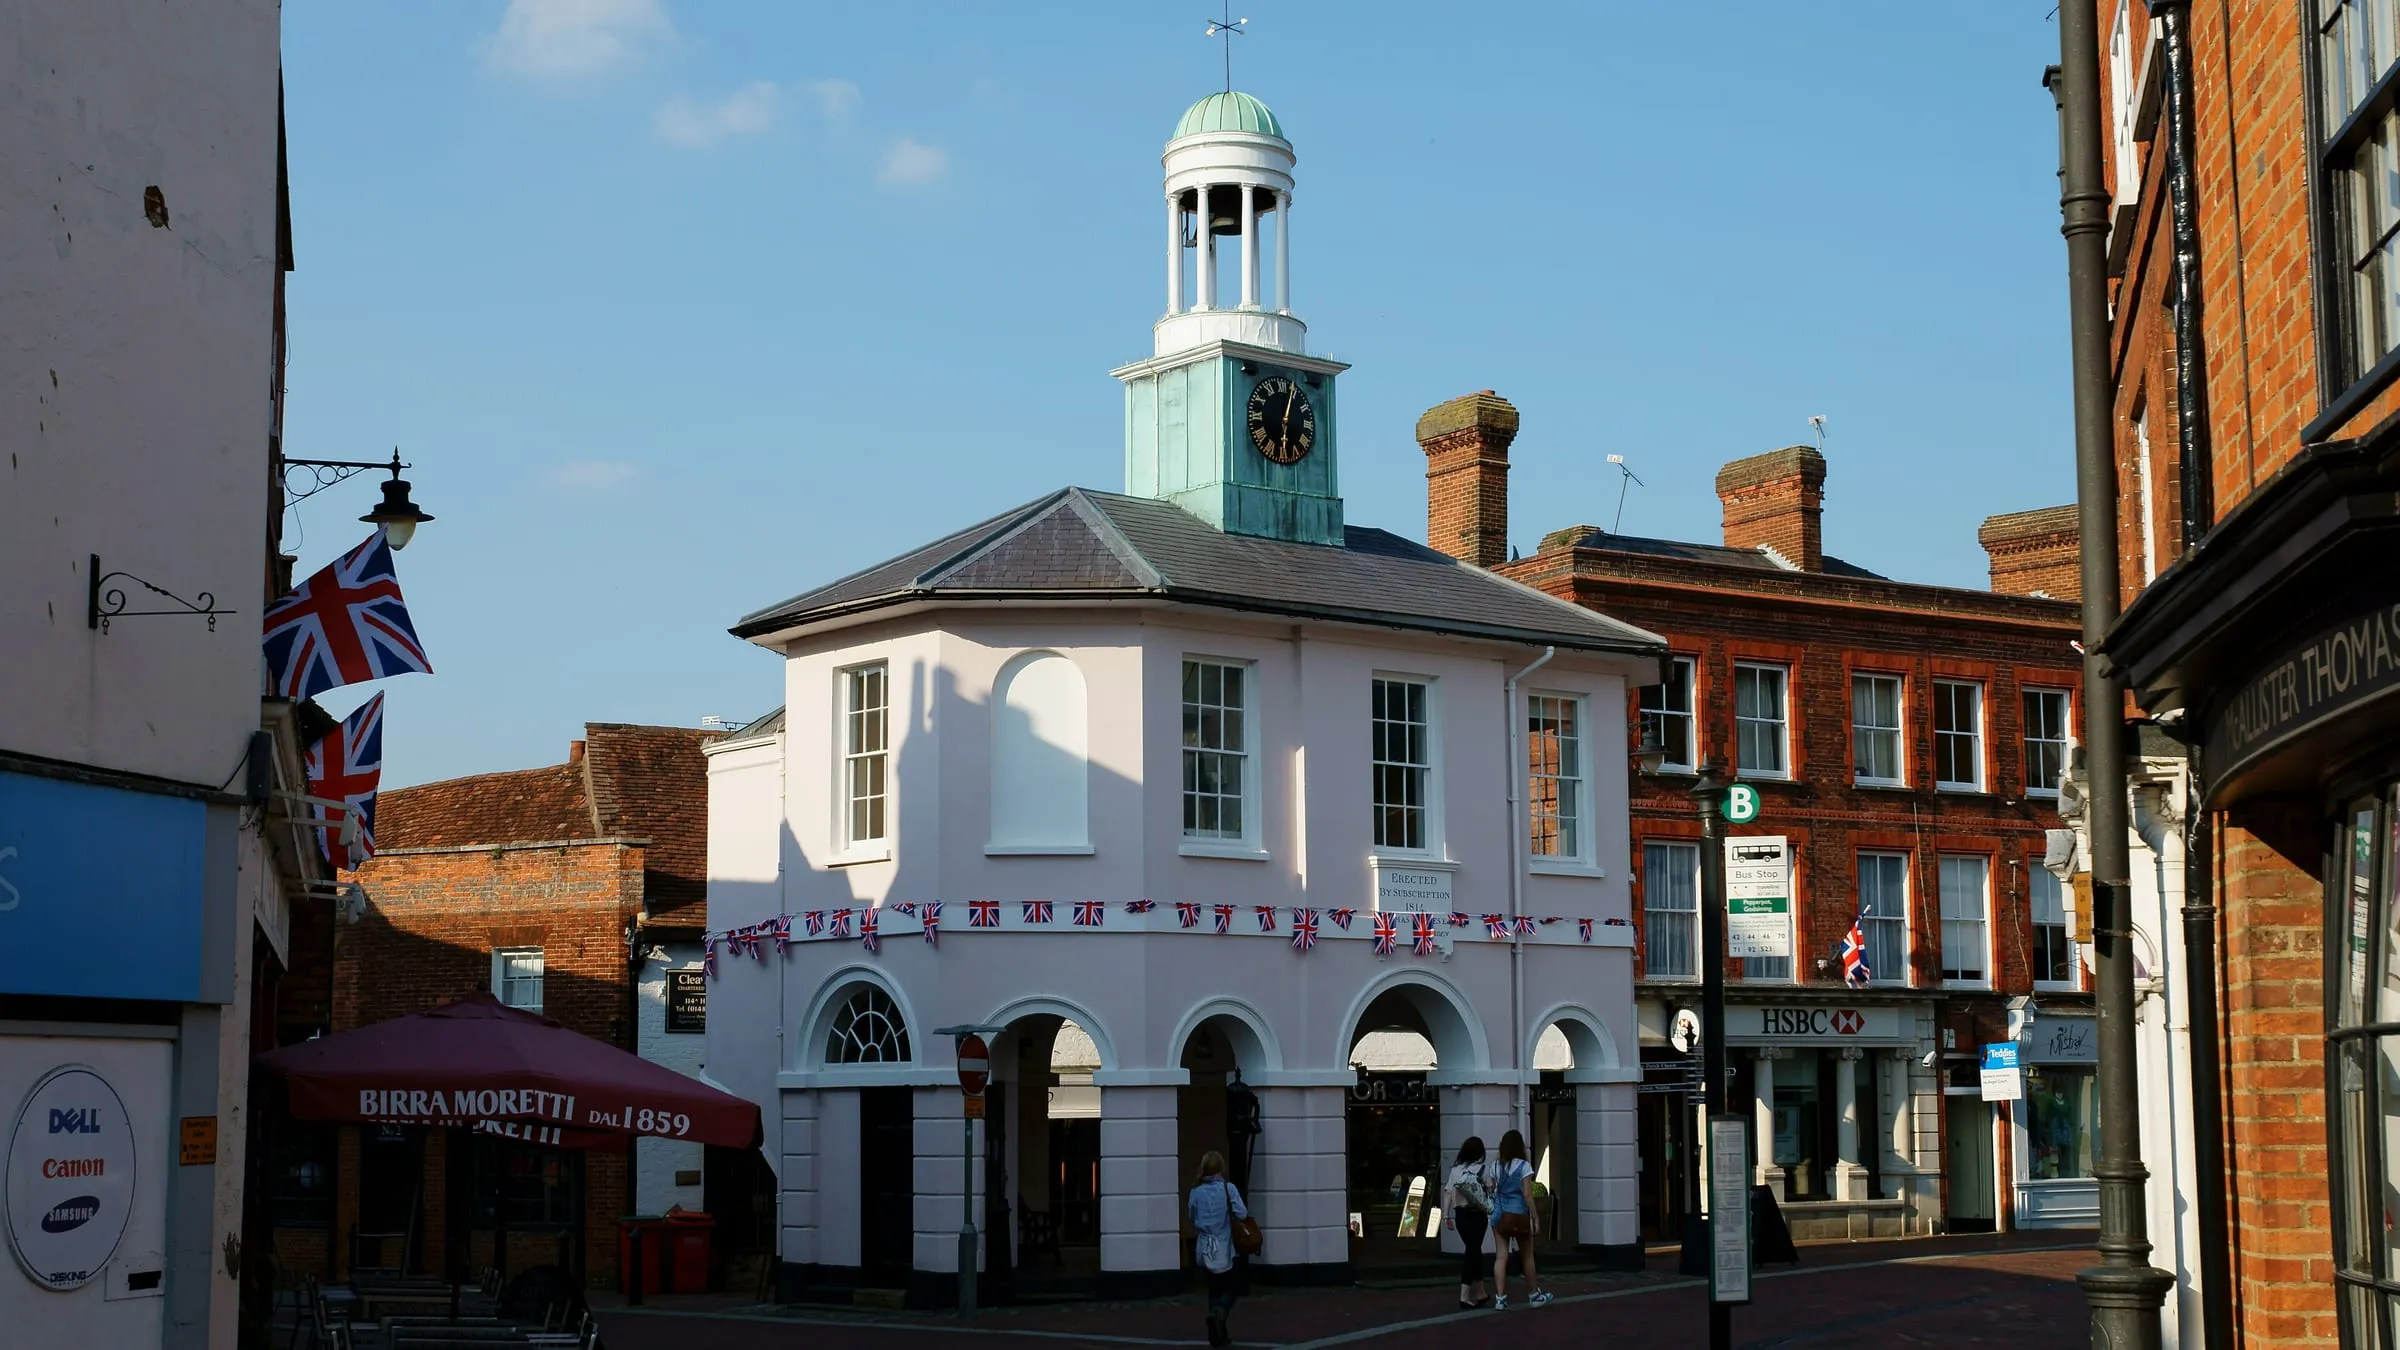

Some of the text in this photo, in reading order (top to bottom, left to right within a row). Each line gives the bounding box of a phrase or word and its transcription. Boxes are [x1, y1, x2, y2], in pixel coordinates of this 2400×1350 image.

[1731, 787, 1753, 818] B
[1391, 873, 1437, 885] ERECTED
[1735, 870, 1778, 879] Bus Stop
[1393, 888, 1450, 900] SUBSCRIPTION
[1760, 1008, 1828, 1035] HSBC
[1990, 1048, 2016, 1058] Teddies
[48, 1108, 100, 1134] DELL
[359, 1089, 691, 1136] BIRRA MORETTI DAL 1859
[42, 1158, 104, 1179] Canon
[48, 1207, 94, 1222] SAMSUNG
